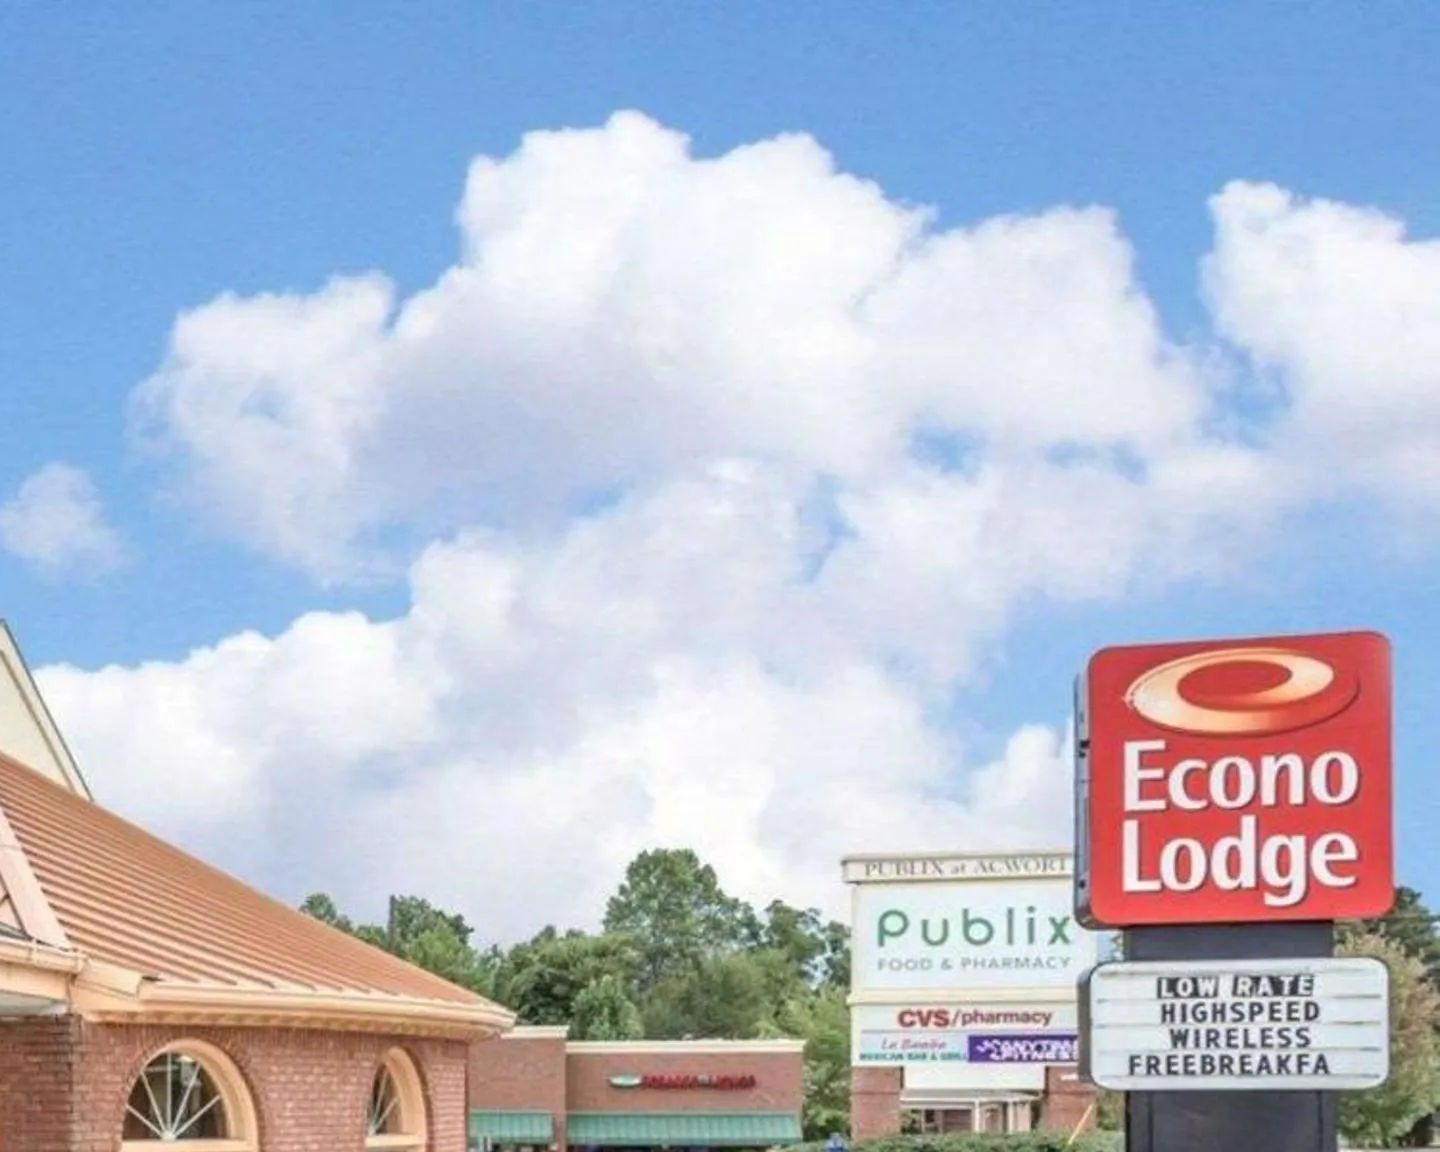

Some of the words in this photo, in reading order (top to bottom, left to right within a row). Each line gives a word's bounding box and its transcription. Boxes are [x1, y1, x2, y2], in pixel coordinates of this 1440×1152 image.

[1123, 739, 1359, 812] Econo
[973, 856, 1068, 874] ACWORT
[1121, 815, 1359, 907] Lodge
[877, 906, 1071, 947] Publix
[877, 957, 934, 971] FOOD
[940, 957, 953, 970] &
[960, 956, 1072, 970] PHARMACY
[1160, 977, 1218, 997] LOW
[1235, 975, 1313, 996] RATE
[898, 1007, 1053, 1028] CVS/pharmacy
[1160, 1001, 1320, 1024] HIGHSPEED
[1169, 1026, 1312, 1049] WIRELESS
[1128, 1053, 1331, 1076] FREEBREAKFA
